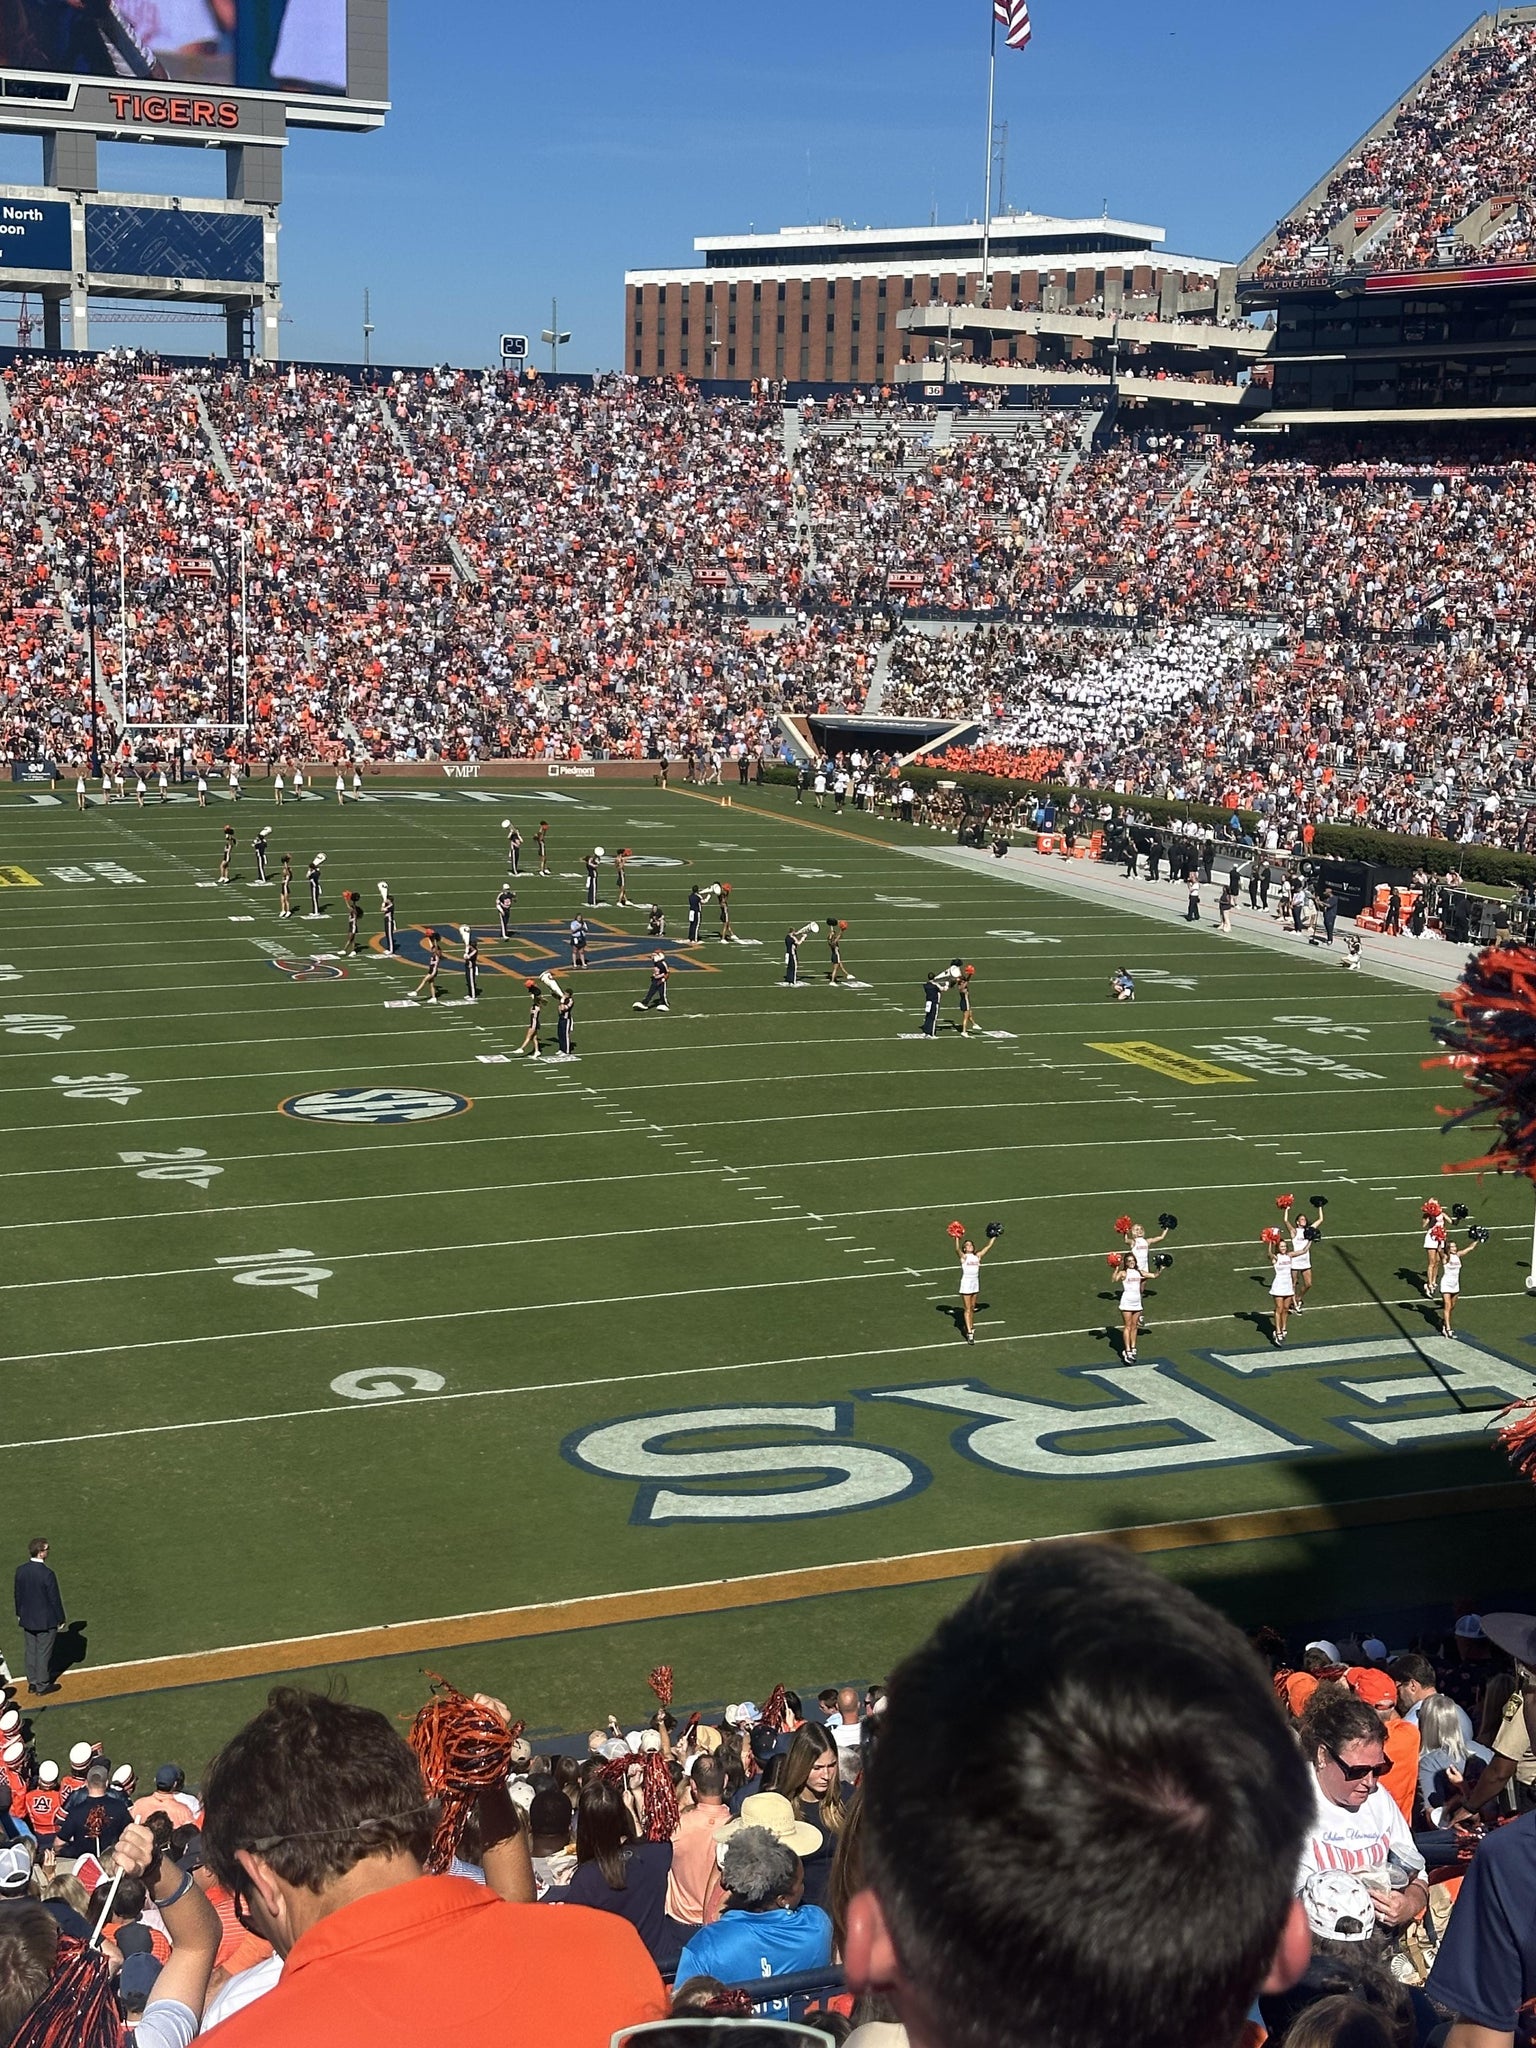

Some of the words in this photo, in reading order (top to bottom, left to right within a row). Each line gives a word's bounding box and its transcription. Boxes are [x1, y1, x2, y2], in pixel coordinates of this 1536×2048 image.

[109, 94, 238, 127] TIGERS
[3, 206, 43, 221] North
[1263, 281, 1280, 289] PAT
[1282, 280, 1299, 288] DYE
[1301, 278, 1328, 287] FIELD
[505, 338, 523, 353] 25
[928, 386, 940, 395] 36
[1206, 434, 1218, 444] 35
[560, 766, 595, 775] Piedmont
[2, 1014, 76, 1035] 40
[1192, 1044, 1308, 1076] FIELD
[1222, 1035, 1312, 1056] PAT
[1291, 1055, 1387, 1080] DYE
[51, 1072, 143, 1099] 30
[118, 1147, 225, 1180] 20
[214, 1247, 334, 1286] 10
[330, 1366, 446, 1400] G
